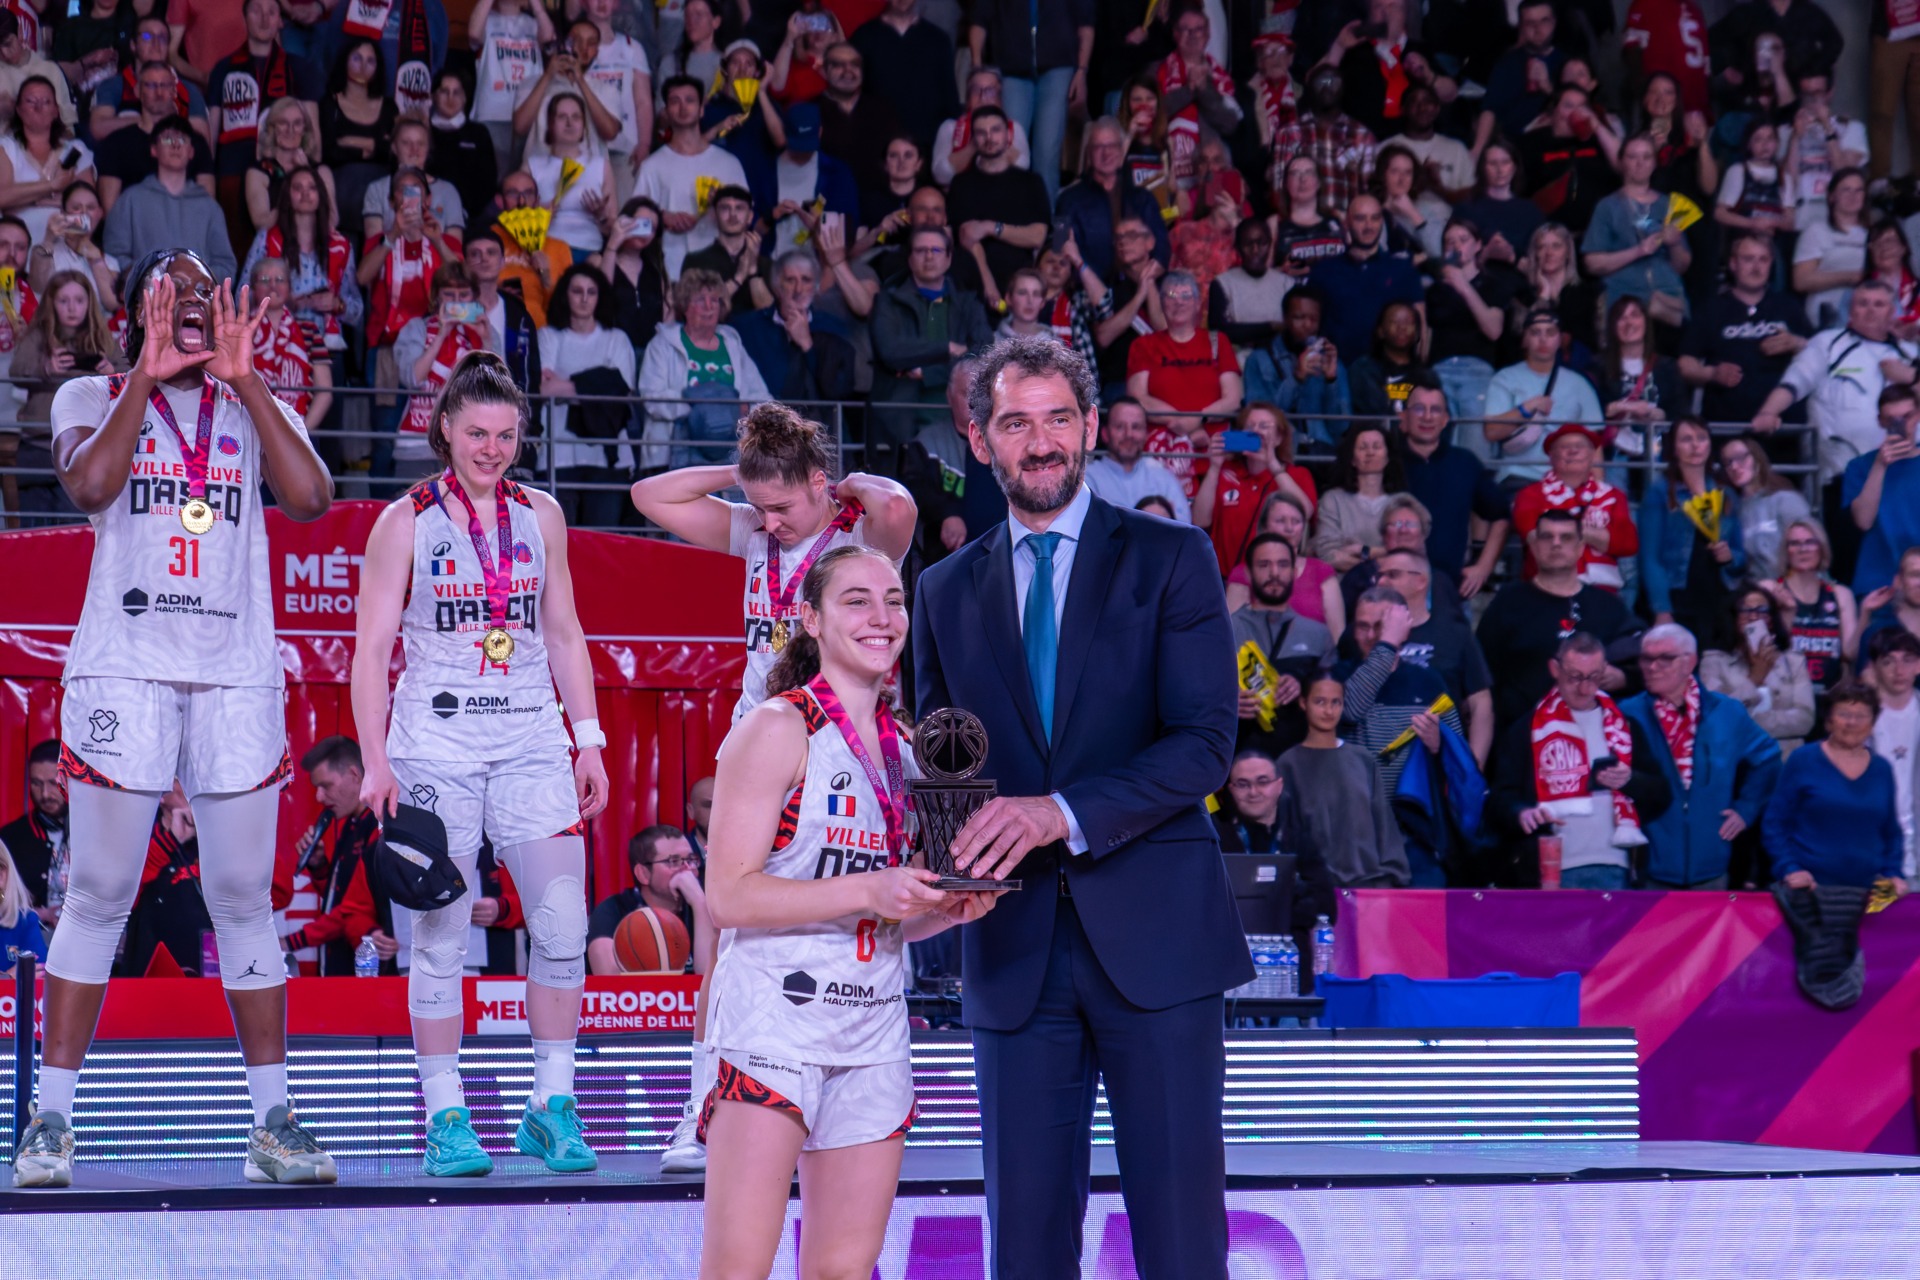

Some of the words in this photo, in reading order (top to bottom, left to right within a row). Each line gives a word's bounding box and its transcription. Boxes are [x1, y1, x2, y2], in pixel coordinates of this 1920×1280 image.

[168, 536, 199, 578] 31
[155, 593, 202, 607] ADIM
[154, 606, 238, 620] HAUTS-DE-FRANCE
[465, 696, 509, 707] ADIM
[856, 918, 877, 962] 0
[825, 982, 874, 998] ADIM
[648, 1015, 666, 1028] DE
[749, 1054, 768, 1062] Région
[748, 1060, 802, 1076] Hauts-de-France
